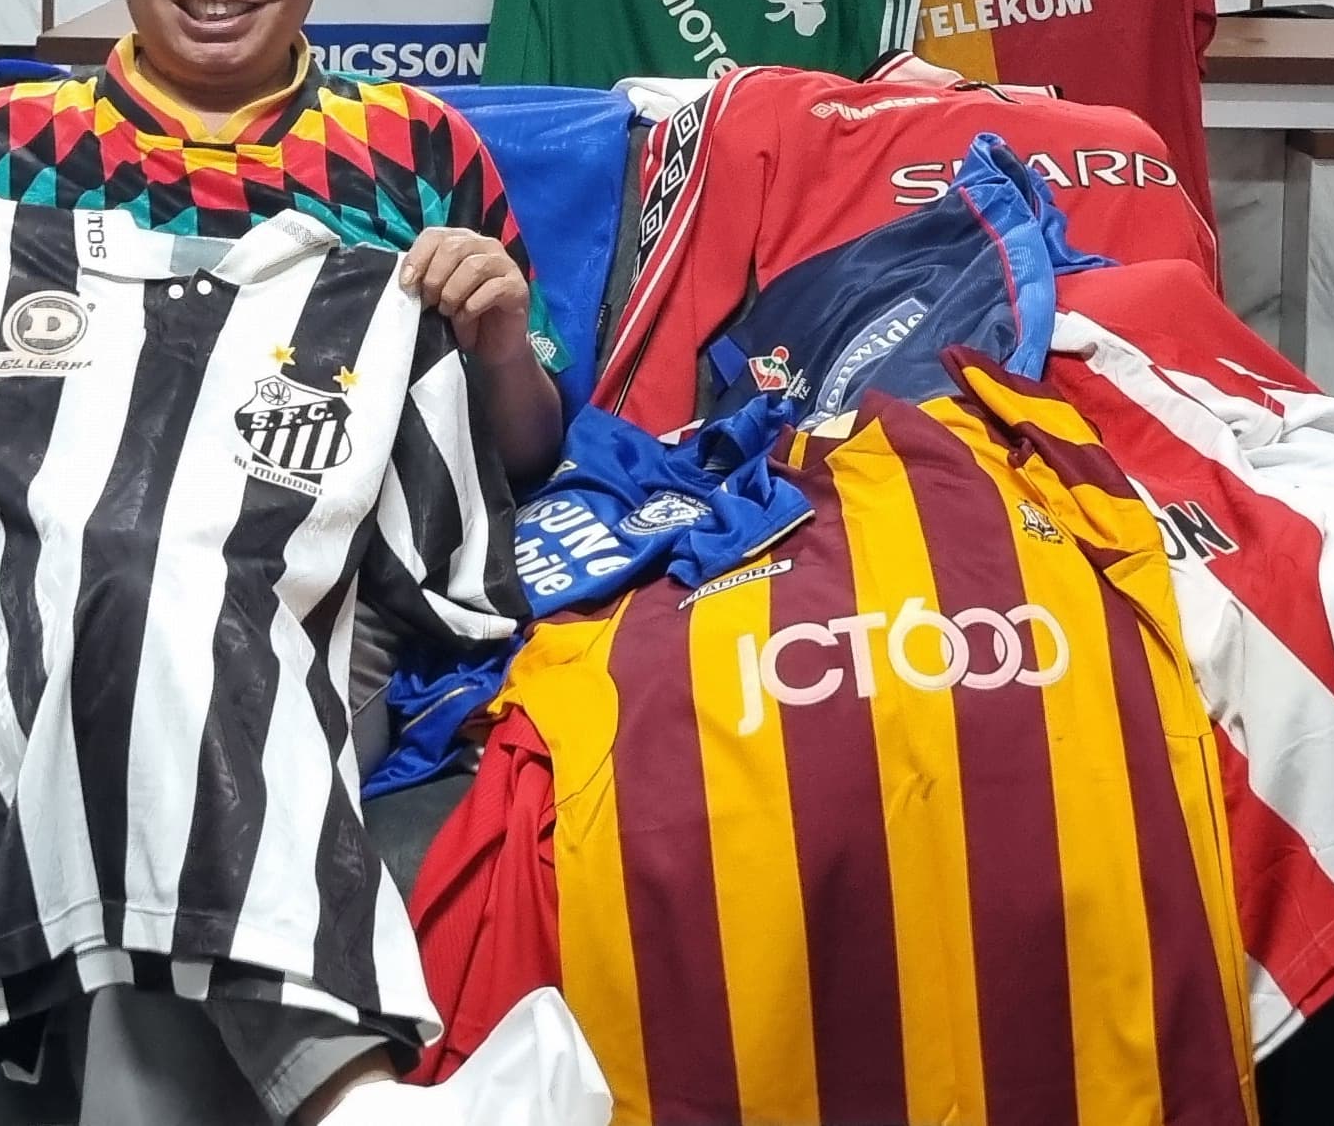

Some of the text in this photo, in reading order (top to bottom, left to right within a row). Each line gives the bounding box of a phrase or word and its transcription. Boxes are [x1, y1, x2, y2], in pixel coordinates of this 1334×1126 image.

[310, 42, 487, 78] RICSSON
[890, 148, 1179, 205] SARP
[87, 211, 107, 259] TOS
[825, 312, 925, 410] onwide
[516, 500, 632, 577] SUNG
[1155, 500, 1238, 561] ON
[736, 597, 1070, 737] JCT600
